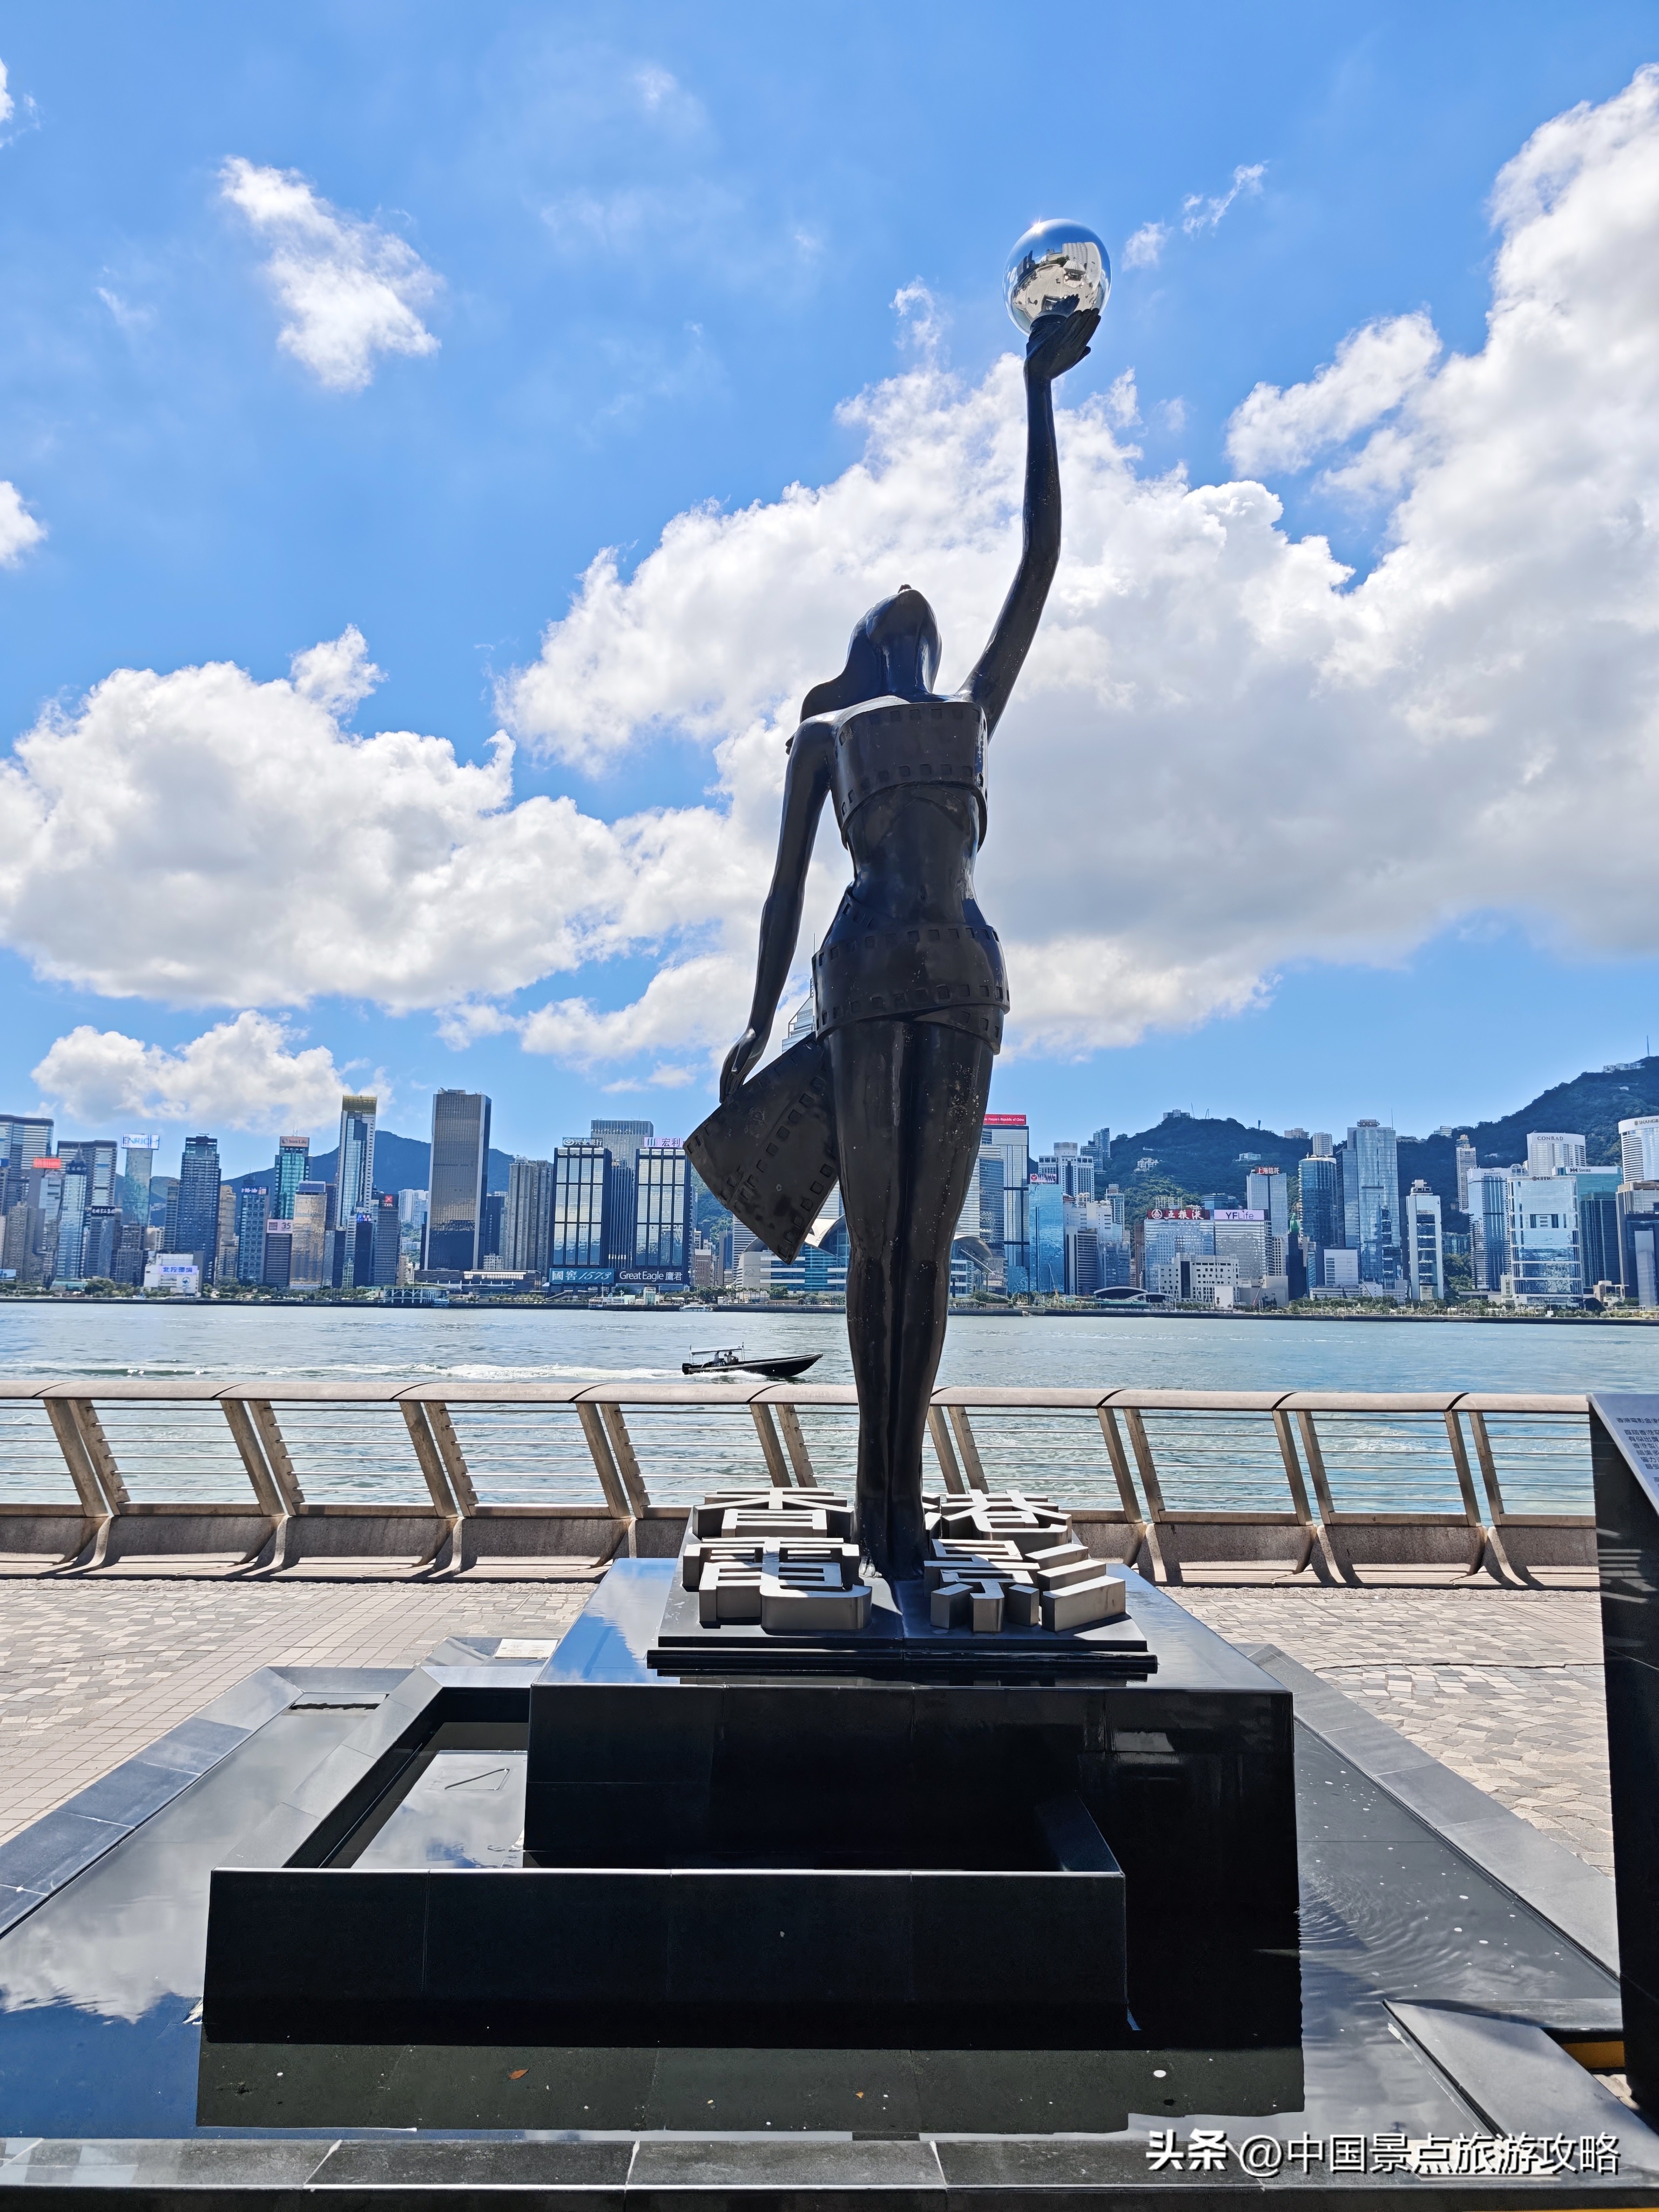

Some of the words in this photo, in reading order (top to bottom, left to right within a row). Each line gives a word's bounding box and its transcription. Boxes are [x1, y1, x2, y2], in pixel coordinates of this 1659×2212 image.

[662, 1137, 680, 1147] 宏利
[1164, 1210, 1205, 1220] 五粮液
[619, 1271, 642, 1280] Great
[642, 1271, 664, 1282] Eagle
[665, 1272, 683, 1282] 鷹君
